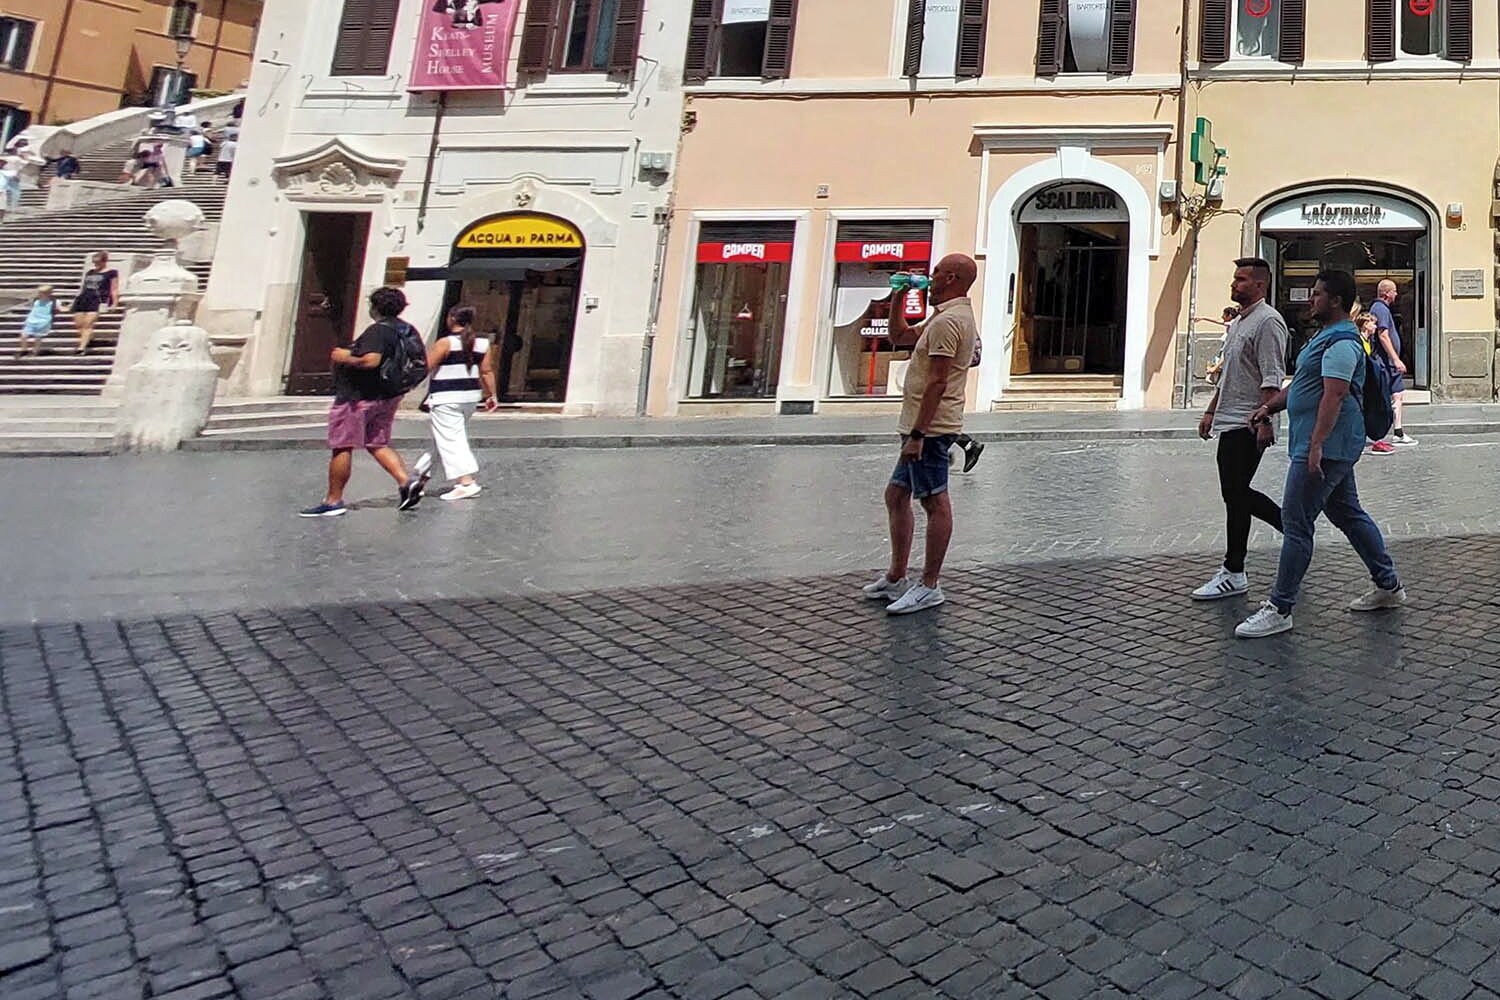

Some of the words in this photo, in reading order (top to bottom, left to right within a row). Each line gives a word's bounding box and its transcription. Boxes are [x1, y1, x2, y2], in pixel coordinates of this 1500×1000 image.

[481, 14, 498, 73] MUSEUM
[427, 60, 464, 75] HOUSE
[1035, 191, 1118, 210] SCALINATA
[1307, 217, 1336, 226] PIAZZA
[1348, 217, 1380, 226] SPAGNA
[468, 233, 512, 244] ACQUA
[530, 232, 574, 243] PARMA
[722, 243, 766, 259] CAMPER
[862, 243, 904, 259] CAMPER
[871, 319, 889, 327] NUO
[860, 327, 889, 335] COLLEZ
